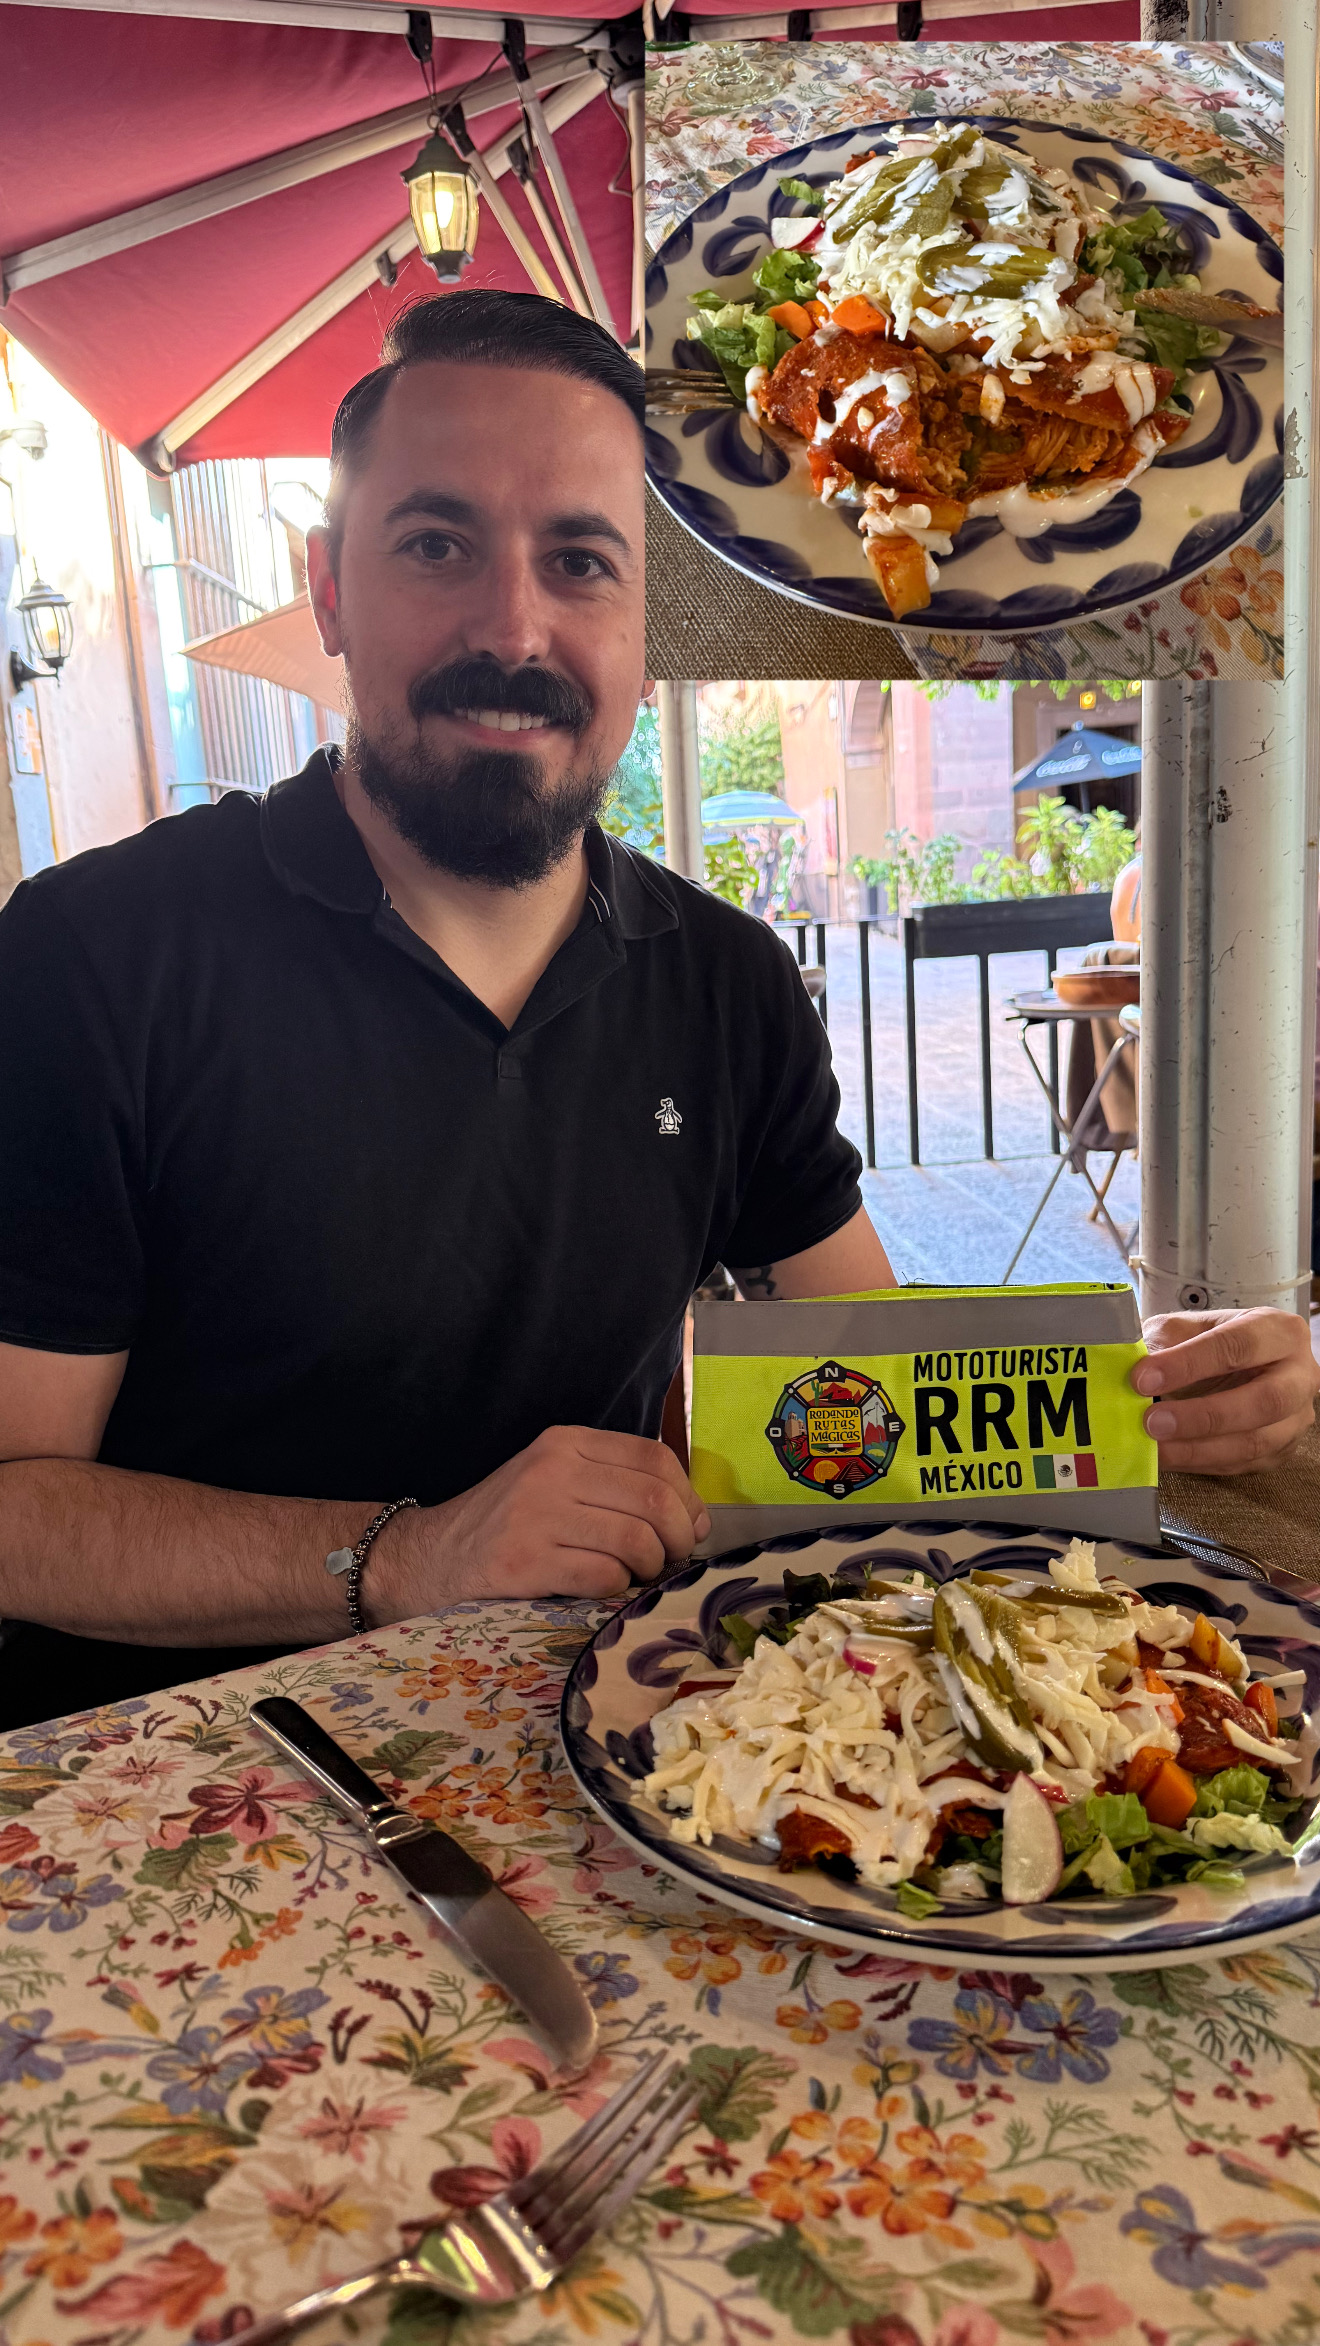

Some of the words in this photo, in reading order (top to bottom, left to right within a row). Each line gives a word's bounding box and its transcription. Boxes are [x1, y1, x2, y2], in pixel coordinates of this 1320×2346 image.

[824, 1367, 839, 1378] N
[913, 1346, 1088, 1383] MOTOTURISTA
[888, 1421, 900, 1432] E
[914, 1376, 1092, 1457] RRM
[833, 1483, 845, 1494] S
[919, 1460, 1023, 1495] MÉXICO
